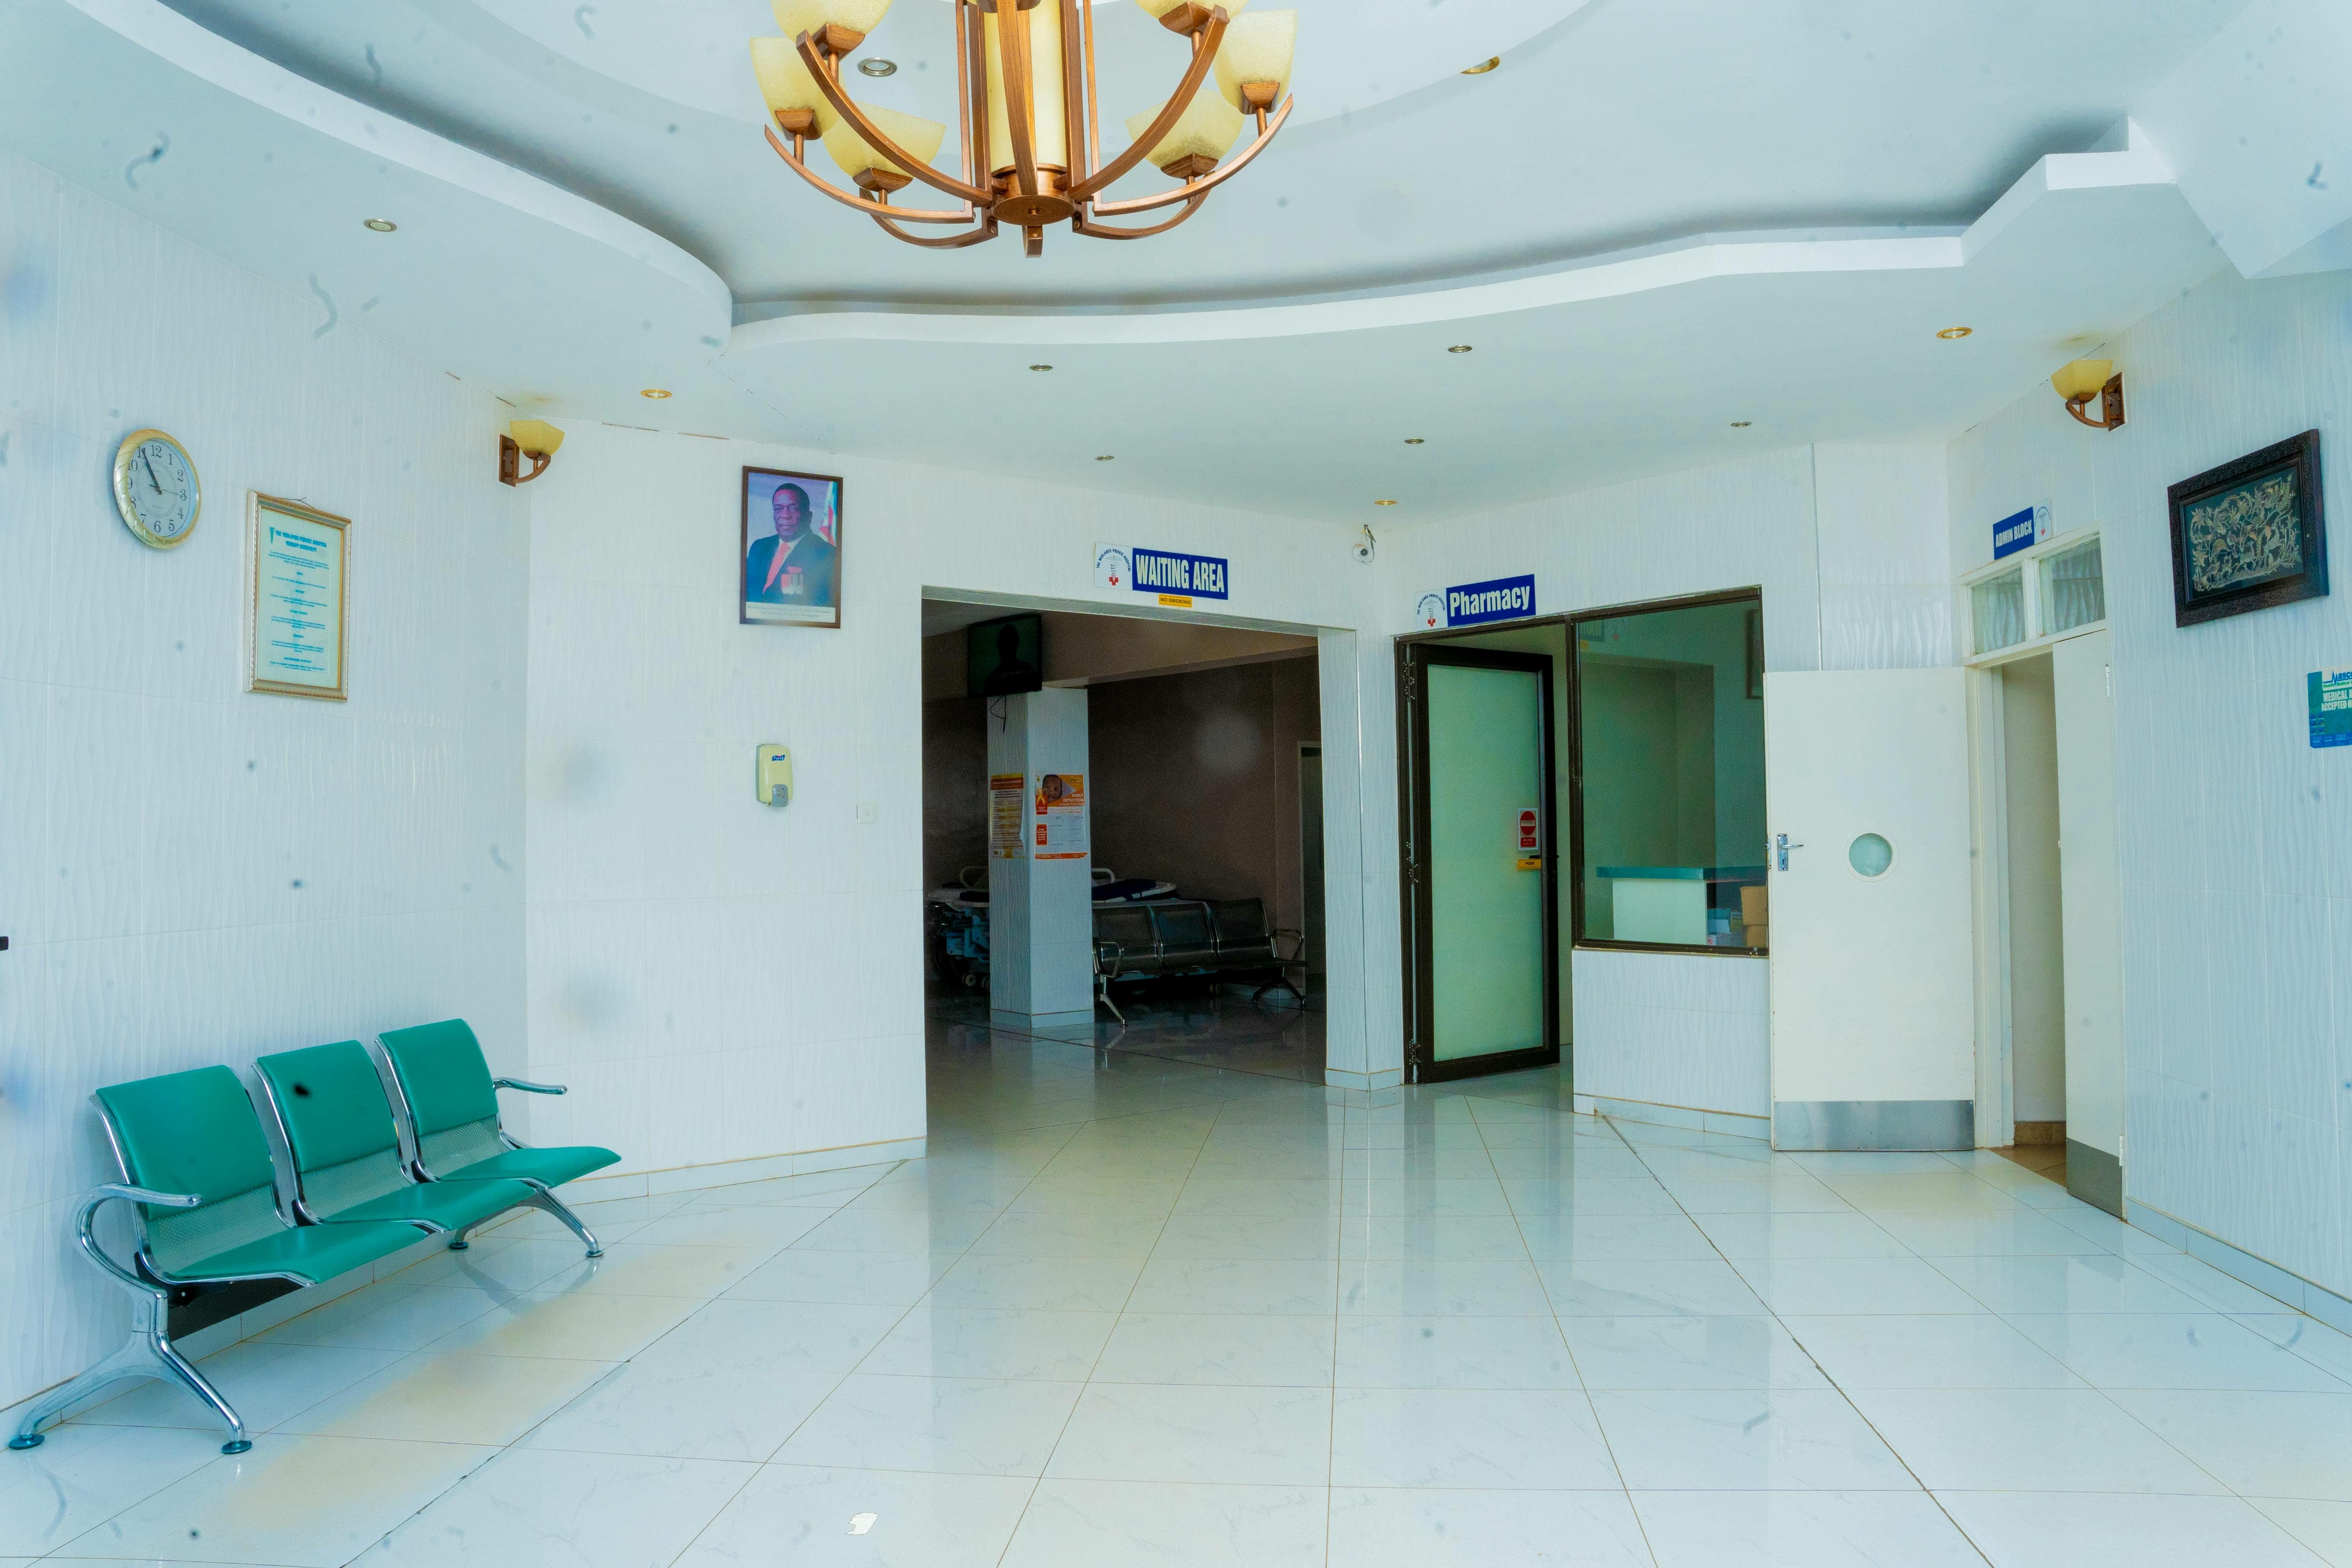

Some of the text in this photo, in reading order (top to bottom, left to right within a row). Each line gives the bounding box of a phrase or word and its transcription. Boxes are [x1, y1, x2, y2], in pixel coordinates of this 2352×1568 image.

[151, 444, 162, 458] 12
[128, 459, 138, 471] 10
[168, 454, 172, 465] 1
[177, 469, 183, 482] 2
[180, 489, 187, 501] 3
[140, 513, 147, 524] 7
[177, 506, 184, 519] 4
[154, 520, 161, 533] 6
[169, 519, 174, 531] 5
[1995, 519, 2033, 548] ADMIN BLOCK
[1113, 548, 1124, 557] PRIVATE
[1136, 554, 1225, 593] WAITING AREA
[1449, 586, 1530, 617] Pharmacy
[2323, 689, 2347, 702] MEDICAL
[2321, 700, 2347, 712] ACCEPTED
